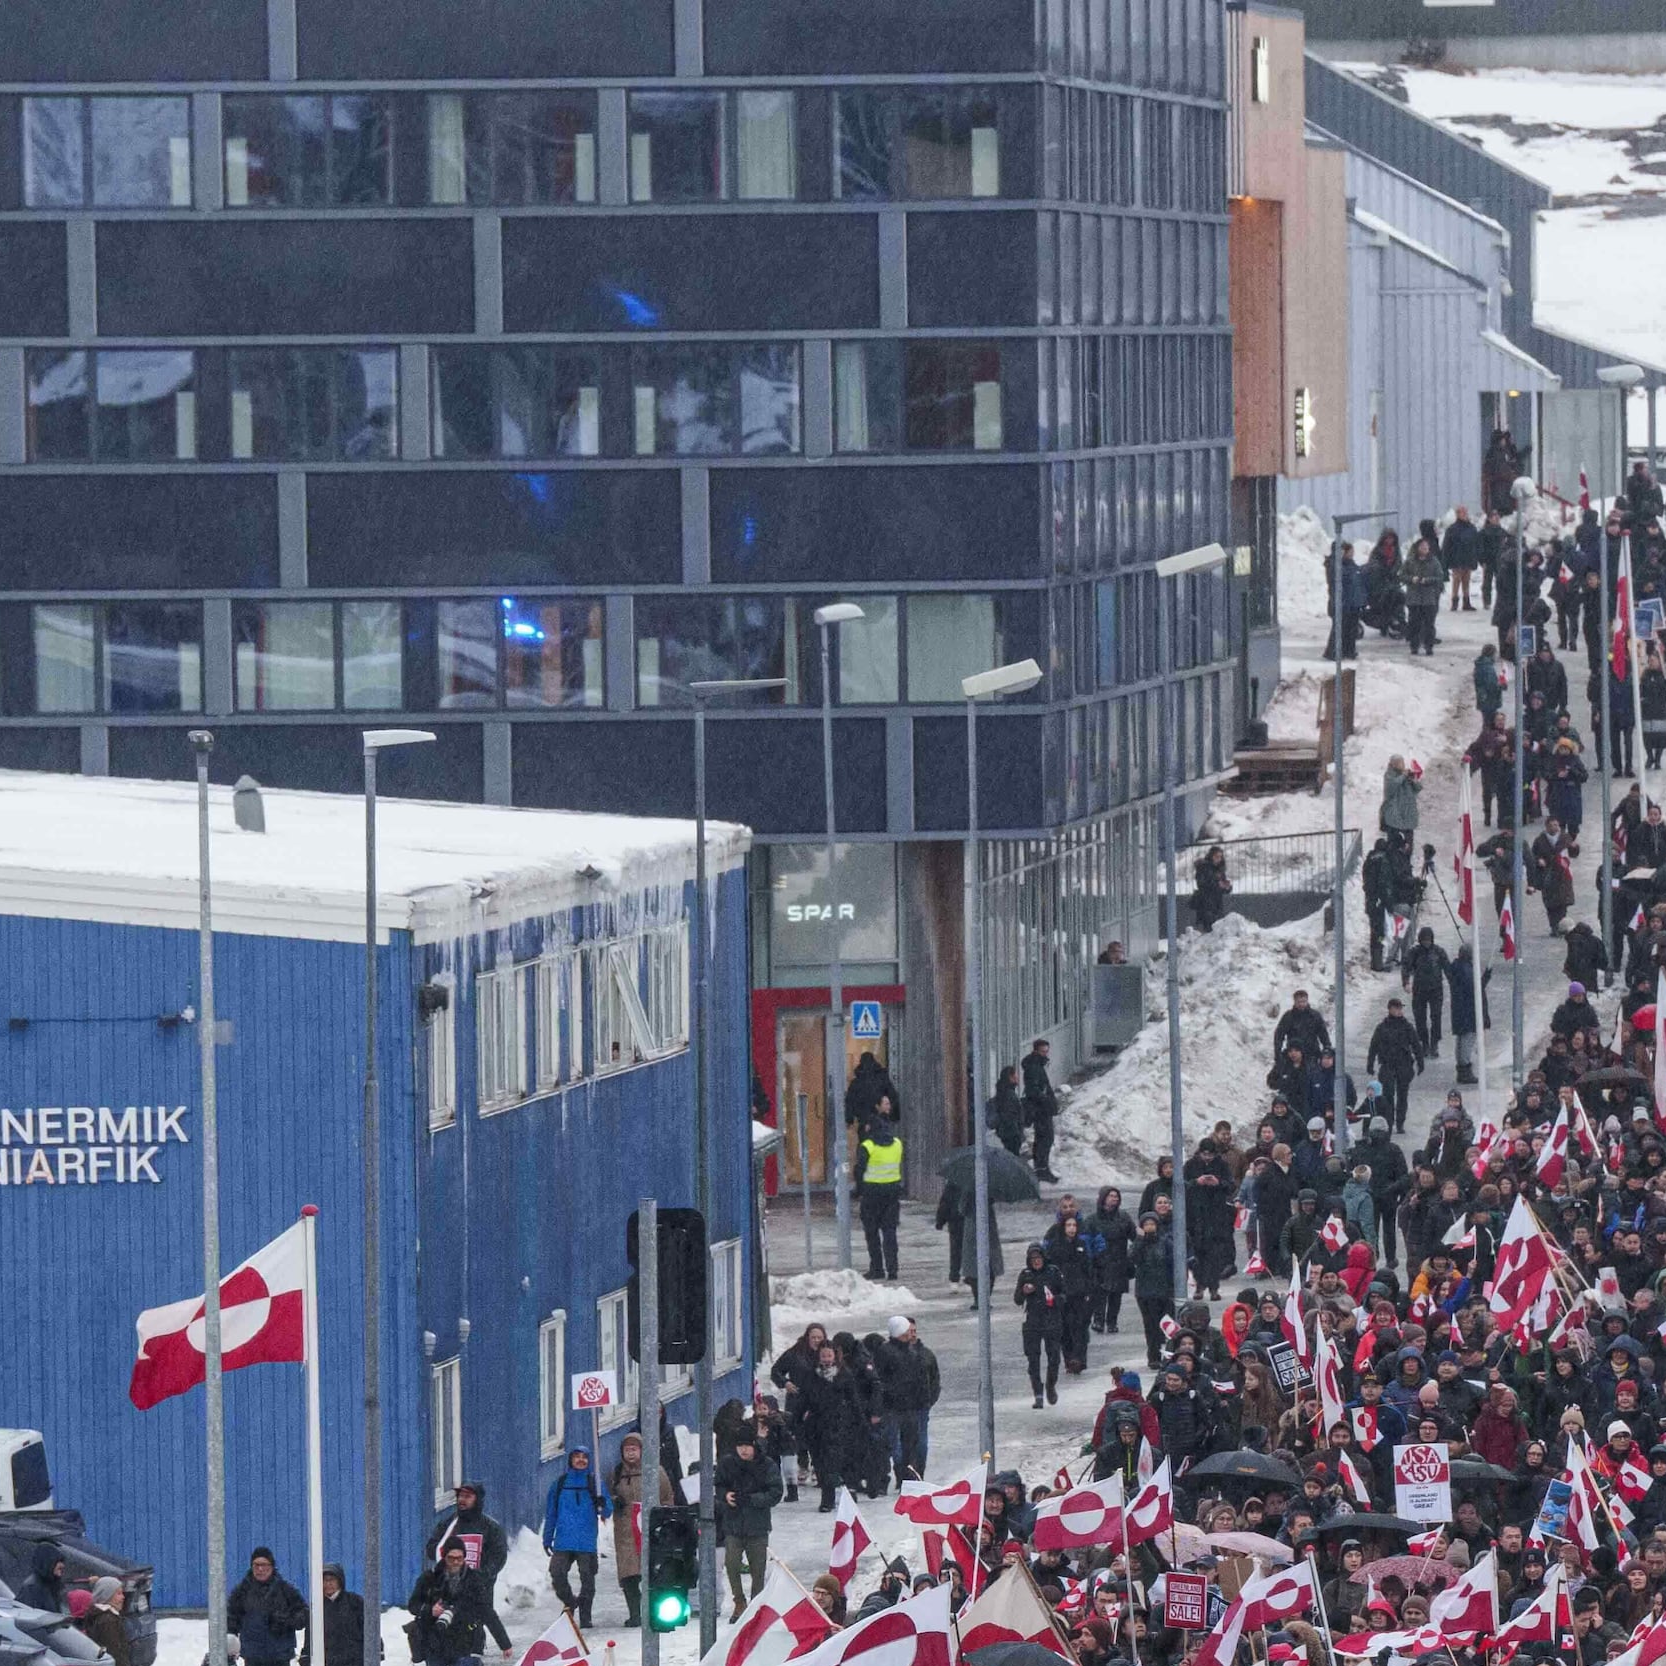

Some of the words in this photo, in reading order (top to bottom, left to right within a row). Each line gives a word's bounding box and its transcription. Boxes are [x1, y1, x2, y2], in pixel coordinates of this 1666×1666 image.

[787, 903, 855, 922] SPAR
[1402, 1447, 1441, 1464] USA
[1170, 1604, 1201, 1621] SALE!
